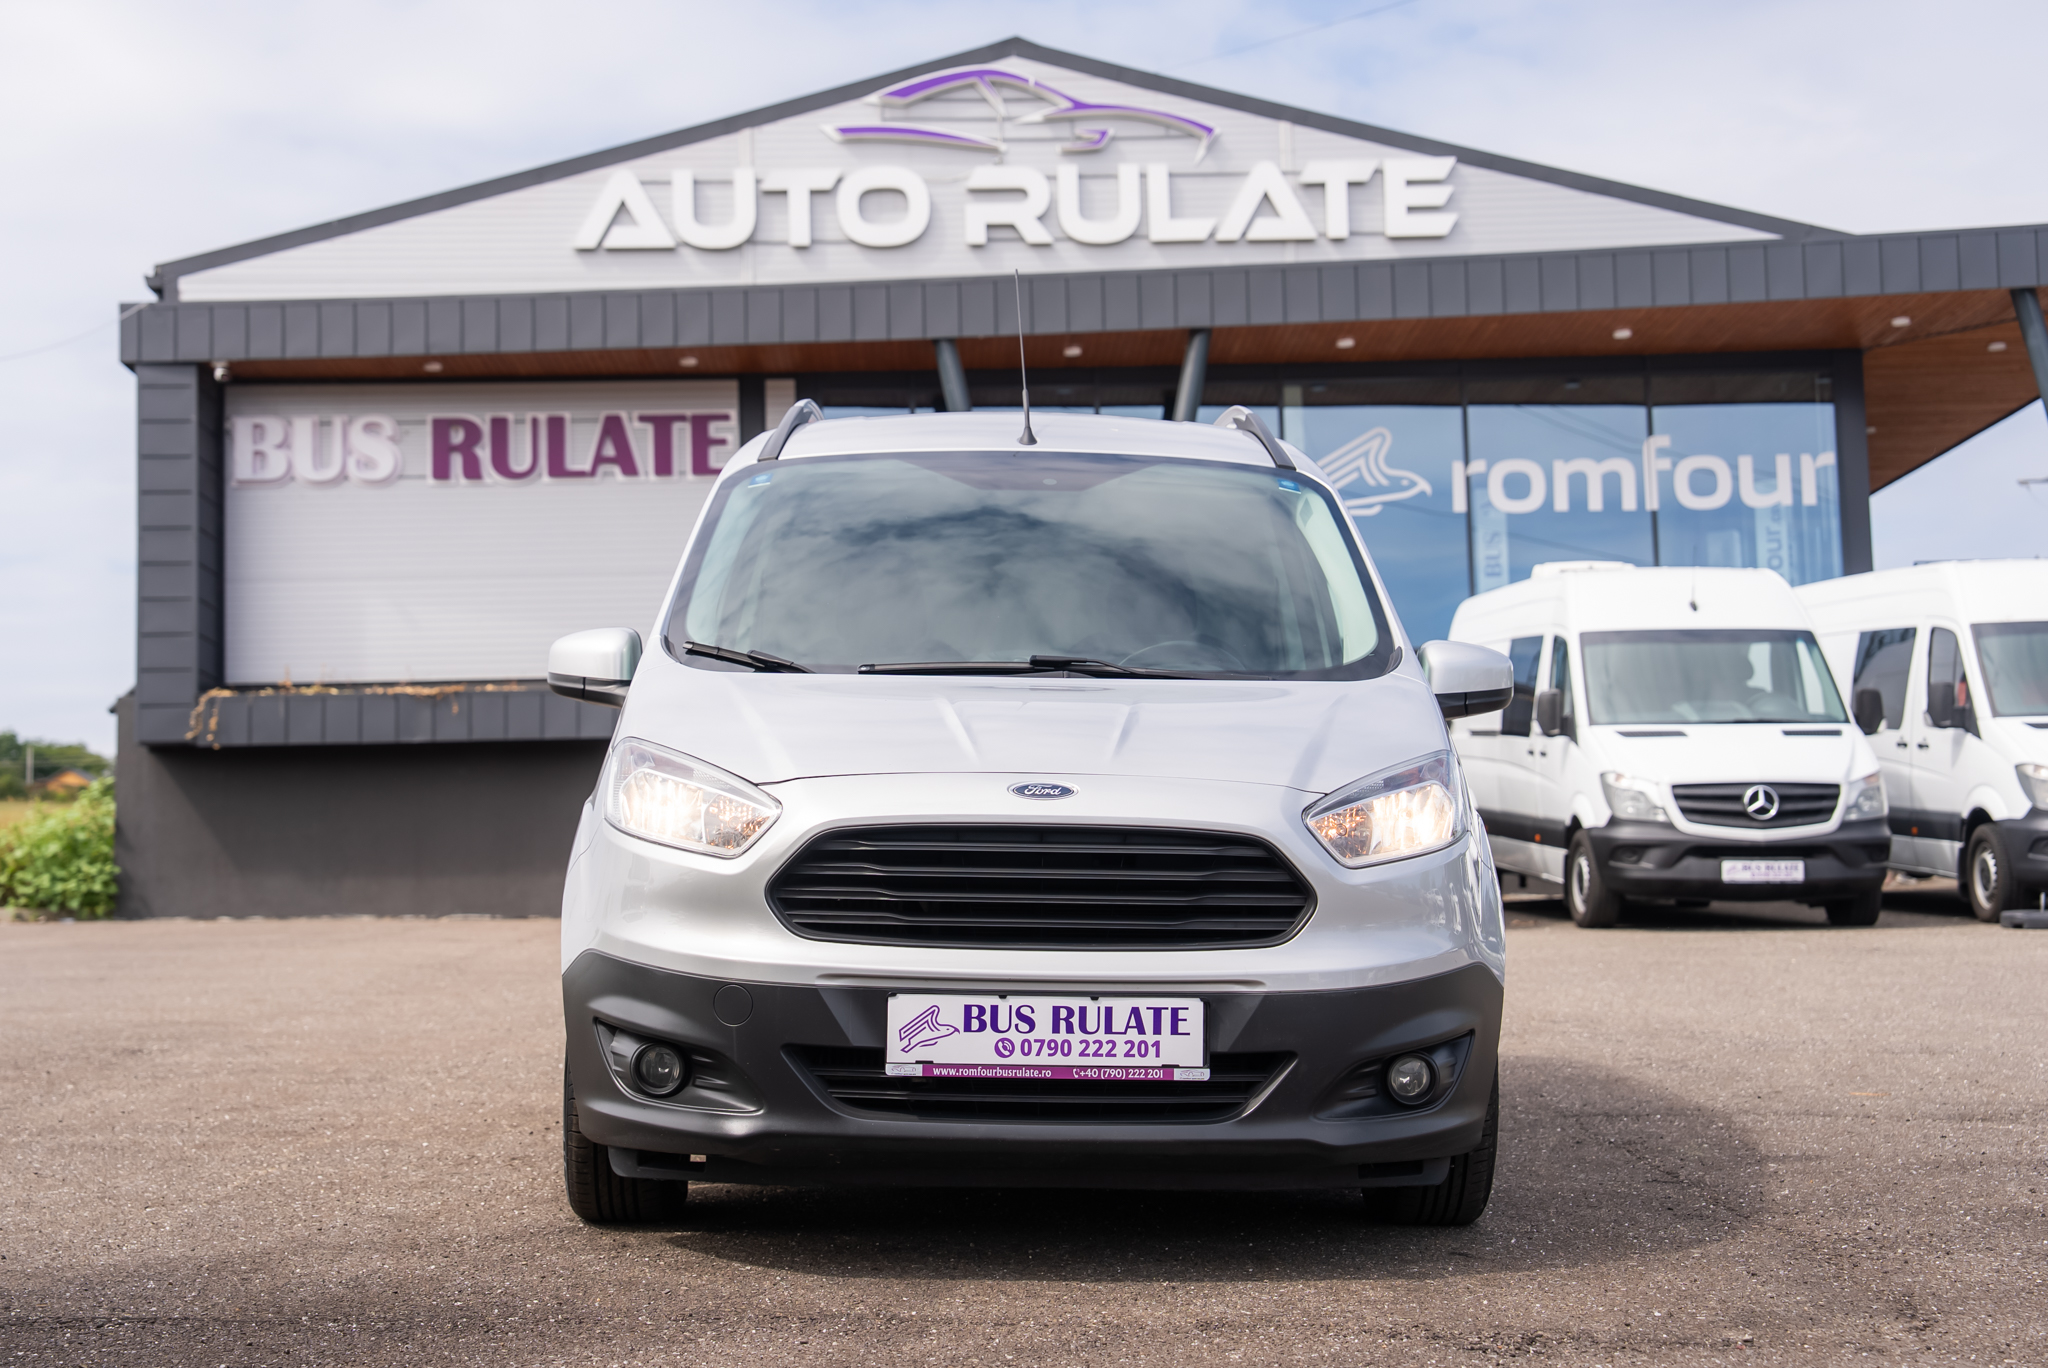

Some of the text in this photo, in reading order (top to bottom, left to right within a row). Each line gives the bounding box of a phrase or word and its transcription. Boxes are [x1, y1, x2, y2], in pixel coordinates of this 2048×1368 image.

[574, 156, 1458, 252] AUTO RULATE
[231, 411, 735, 484] BUS RULATE
[1452, 435, 1835, 513] romfour
[1024, 784, 1062, 795] Ford
[963, 1004, 1190, 1036] BUS RULATE
[1020, 1039, 1161, 1059] 0790 222 201
[933, 1065, 1163, 1080] www.romfourbusrulate.ro +40 (790) 222 201
